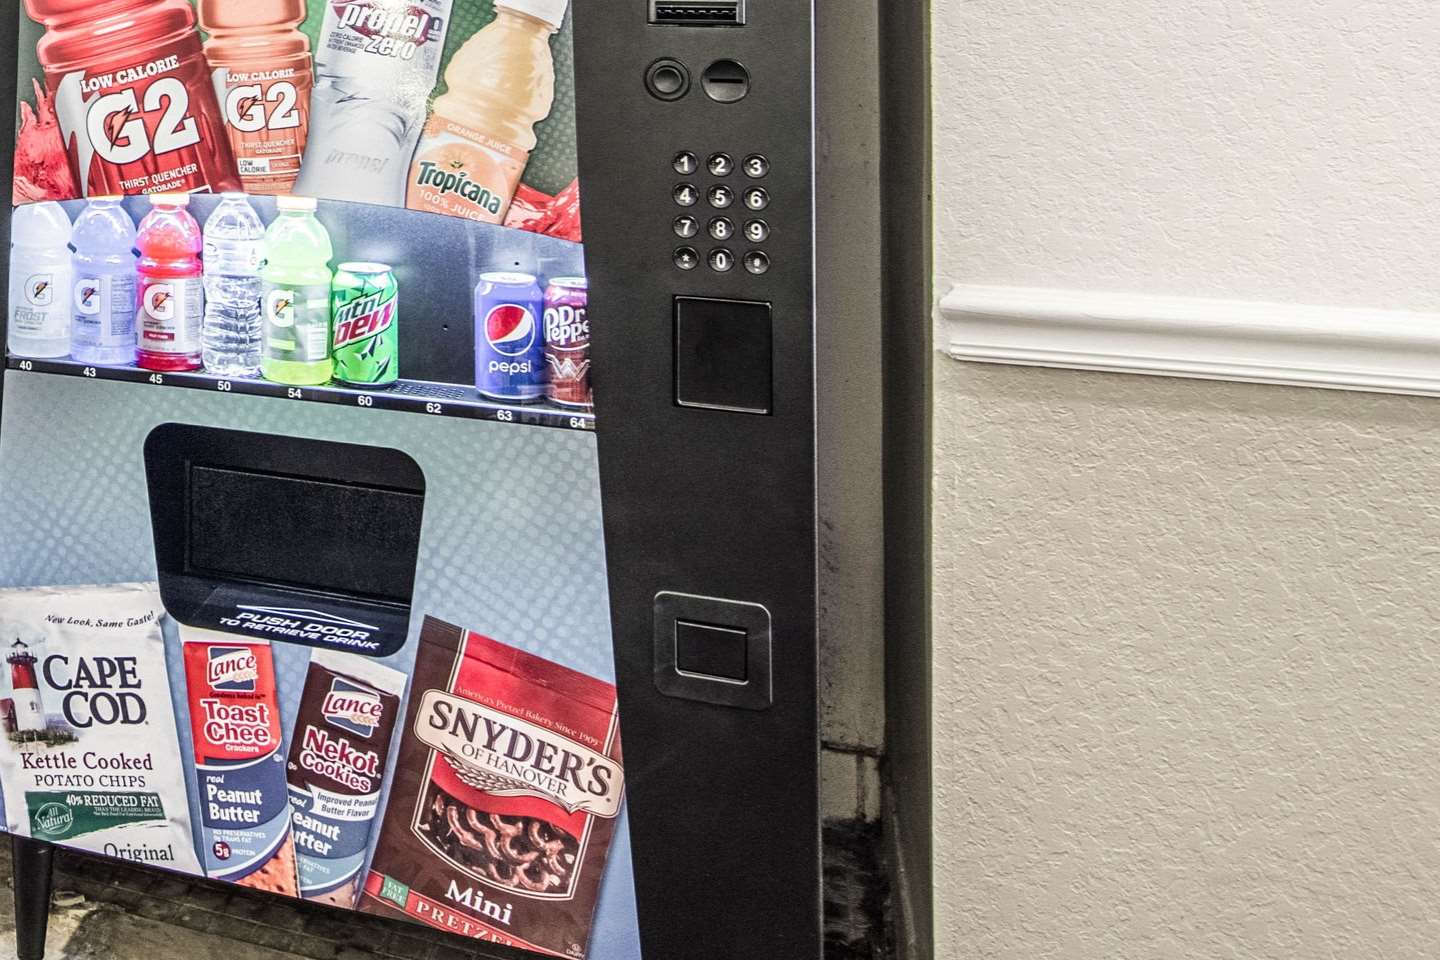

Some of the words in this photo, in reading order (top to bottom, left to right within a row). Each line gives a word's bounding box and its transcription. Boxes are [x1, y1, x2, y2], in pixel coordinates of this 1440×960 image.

[337, 4, 429, 39] propel
[365, 34, 417, 61] zero
[80, 77, 113, 92] LOW
[117, 55, 179, 86] CALORIE
[226, 73, 248, 83] LOW
[251, 68, 295, 81] CALORIE
[226, 82, 302, 132] G2
[86, 77, 201, 164] G2
[447, 122, 485, 143] ORANGE
[487, 138, 513, 154] JUICE
[680, 156, 688, 171] 1
[715, 158, 726, 172] 2
[750, 159, 761, 175] 3
[119, 173, 149, 190] THIRST
[152, 163, 198, 183] QUENCHER
[417, 161, 502, 215] Tropicana
[680, 188, 691, 203] 4
[419, 190, 449, 209] 100%
[715, 190, 725, 205] 5
[751, 191, 762, 207] 6
[681, 220, 691, 235] 7
[716, 221, 726, 237] 8
[751, 223, 762, 239] 9
[716, 253, 726, 268] 0
[24, 274, 53, 306] G
[74, 278, 101, 315] G
[144, 283, 175, 321] G
[267, 289, 296, 327] G
[15, 311, 48, 322] FROST
[558, 306, 585, 322] Dr
[20, 360, 32, 370] 40
[83, 367, 96, 377] 43
[488, 359, 531, 376] pepsi
[149, 373, 162, 384] 45
[217, 381, 231, 391] 50
[288, 388, 302, 398] 54
[358, 396, 372, 406] 60
[426, 403, 441, 414] 62
[497, 410, 512, 421] 63
[570, 418, 585, 428] 64
[45, 614, 65, 623] New
[66, 617, 93, 627] Look,
[96, 619, 123, 628] Same
[236, 613, 297, 629] PUSH
[303, 622, 369, 640] DOOR
[220, 617, 238, 626] TO
[242, 621, 321, 640] RETRIEVE
[323, 634, 379, 649] DRINK
[43, 655, 141, 690] CAPE
[209, 654, 255, 683] Lance
[62, 691, 147, 728] COD
[201, 699, 269, 726] Toast
[324, 695, 382, 716] Lance
[456, 687, 496, 707] America's
[496, 700, 525, 716] Pretzel
[526, 709, 553, 728] Bakery
[554, 721, 578, 738] Since
[205, 721, 270, 745] Chee
[225, 744, 259, 753] Crackers
[304, 726, 378, 777] Nekot
[429, 700, 611, 797] SNYDER'S
[21, 752, 77, 769] Kettle
[83, 752, 153, 770] Cooked
[206, 774, 225, 784] real
[300, 751, 370, 792] Cookies
[462, 743, 483, 761] OF
[486, 754, 568, 798] HANOVER
[34, 774, 94, 787] POTATO
[99, 775, 146, 787] CHIPS
[66, 794, 84, 805] 40%
[84, 794, 137, 807] REDUCED
[140, 796, 159, 807] FAT
[207, 784, 262, 805] Peanut
[317, 792, 352, 806] Improved
[36, 809, 73, 829] Natural
[49, 807, 59, 817] All
[209, 804, 260, 823] Butter
[321, 804, 344, 815] Butter
[346, 808, 370, 817] Flavor
[104, 843, 174, 863] Original
[215, 843, 230, 858] 5g
[445, 879, 512, 925] Mini
